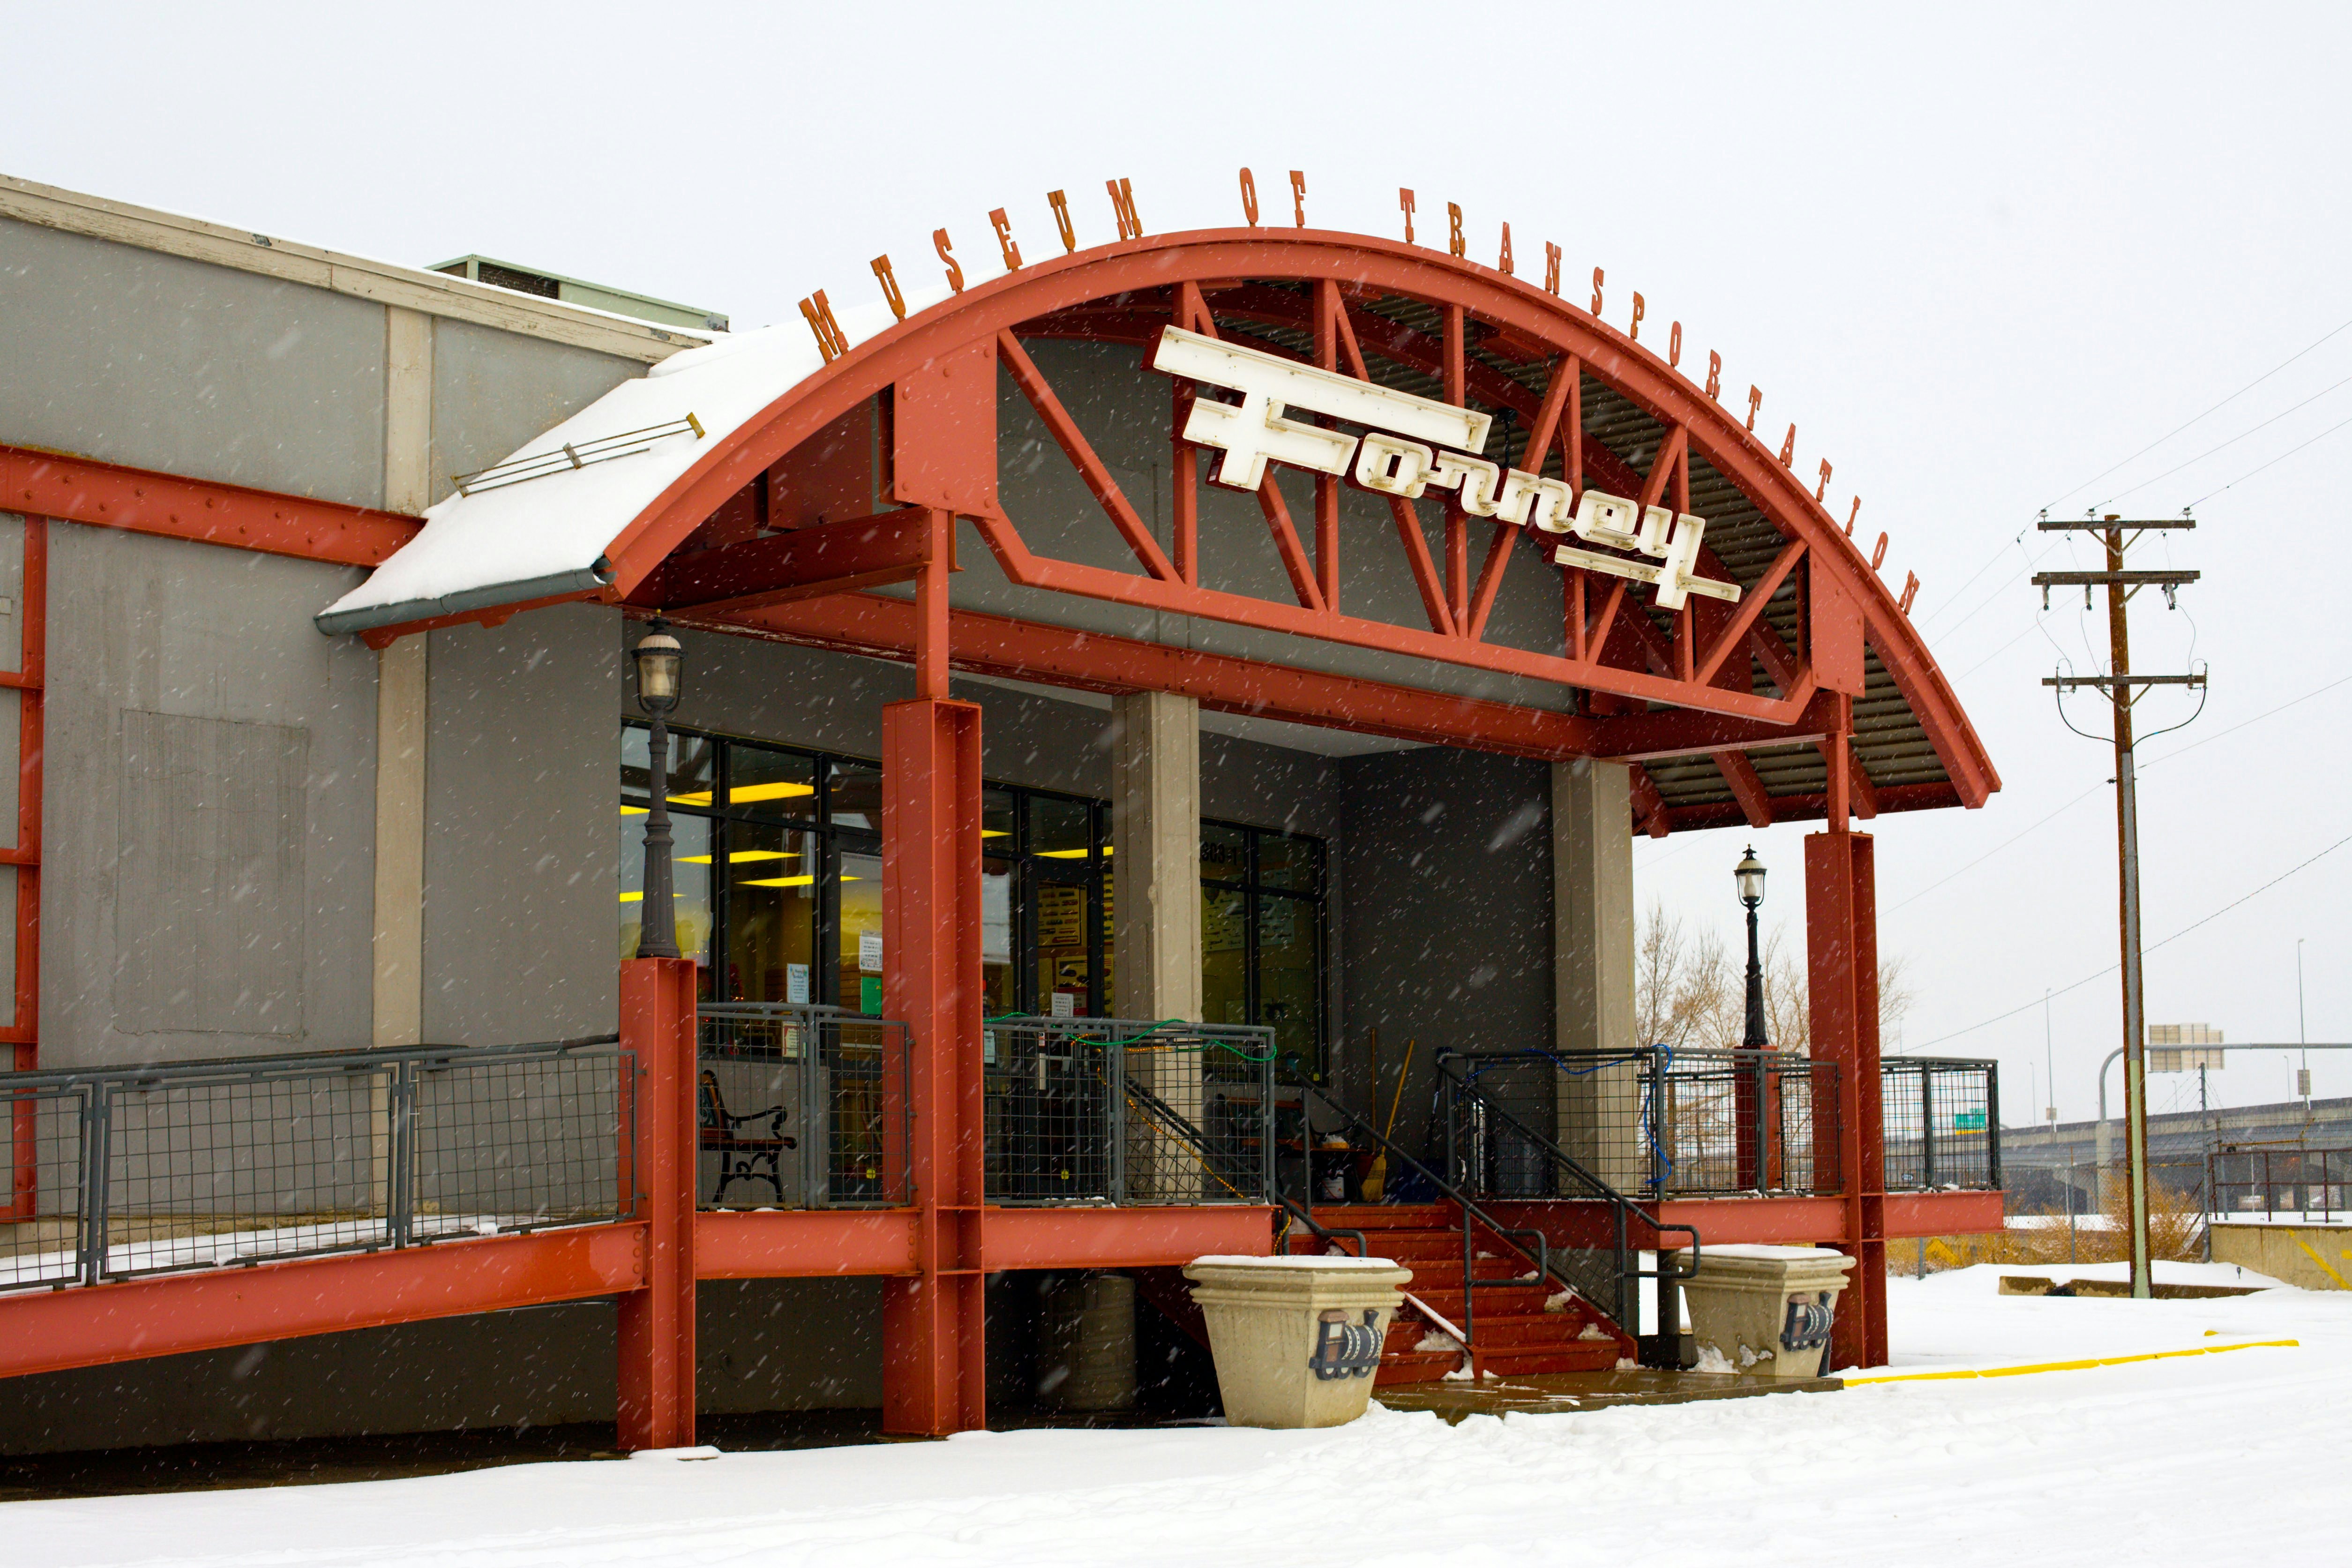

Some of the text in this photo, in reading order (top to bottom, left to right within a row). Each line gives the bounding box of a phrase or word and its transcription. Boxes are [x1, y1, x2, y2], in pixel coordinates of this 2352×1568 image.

[798, 167, 1920, 615] MUSEUM OF TRANSPORTATION
[1152, 324, 1742, 610] Forney
